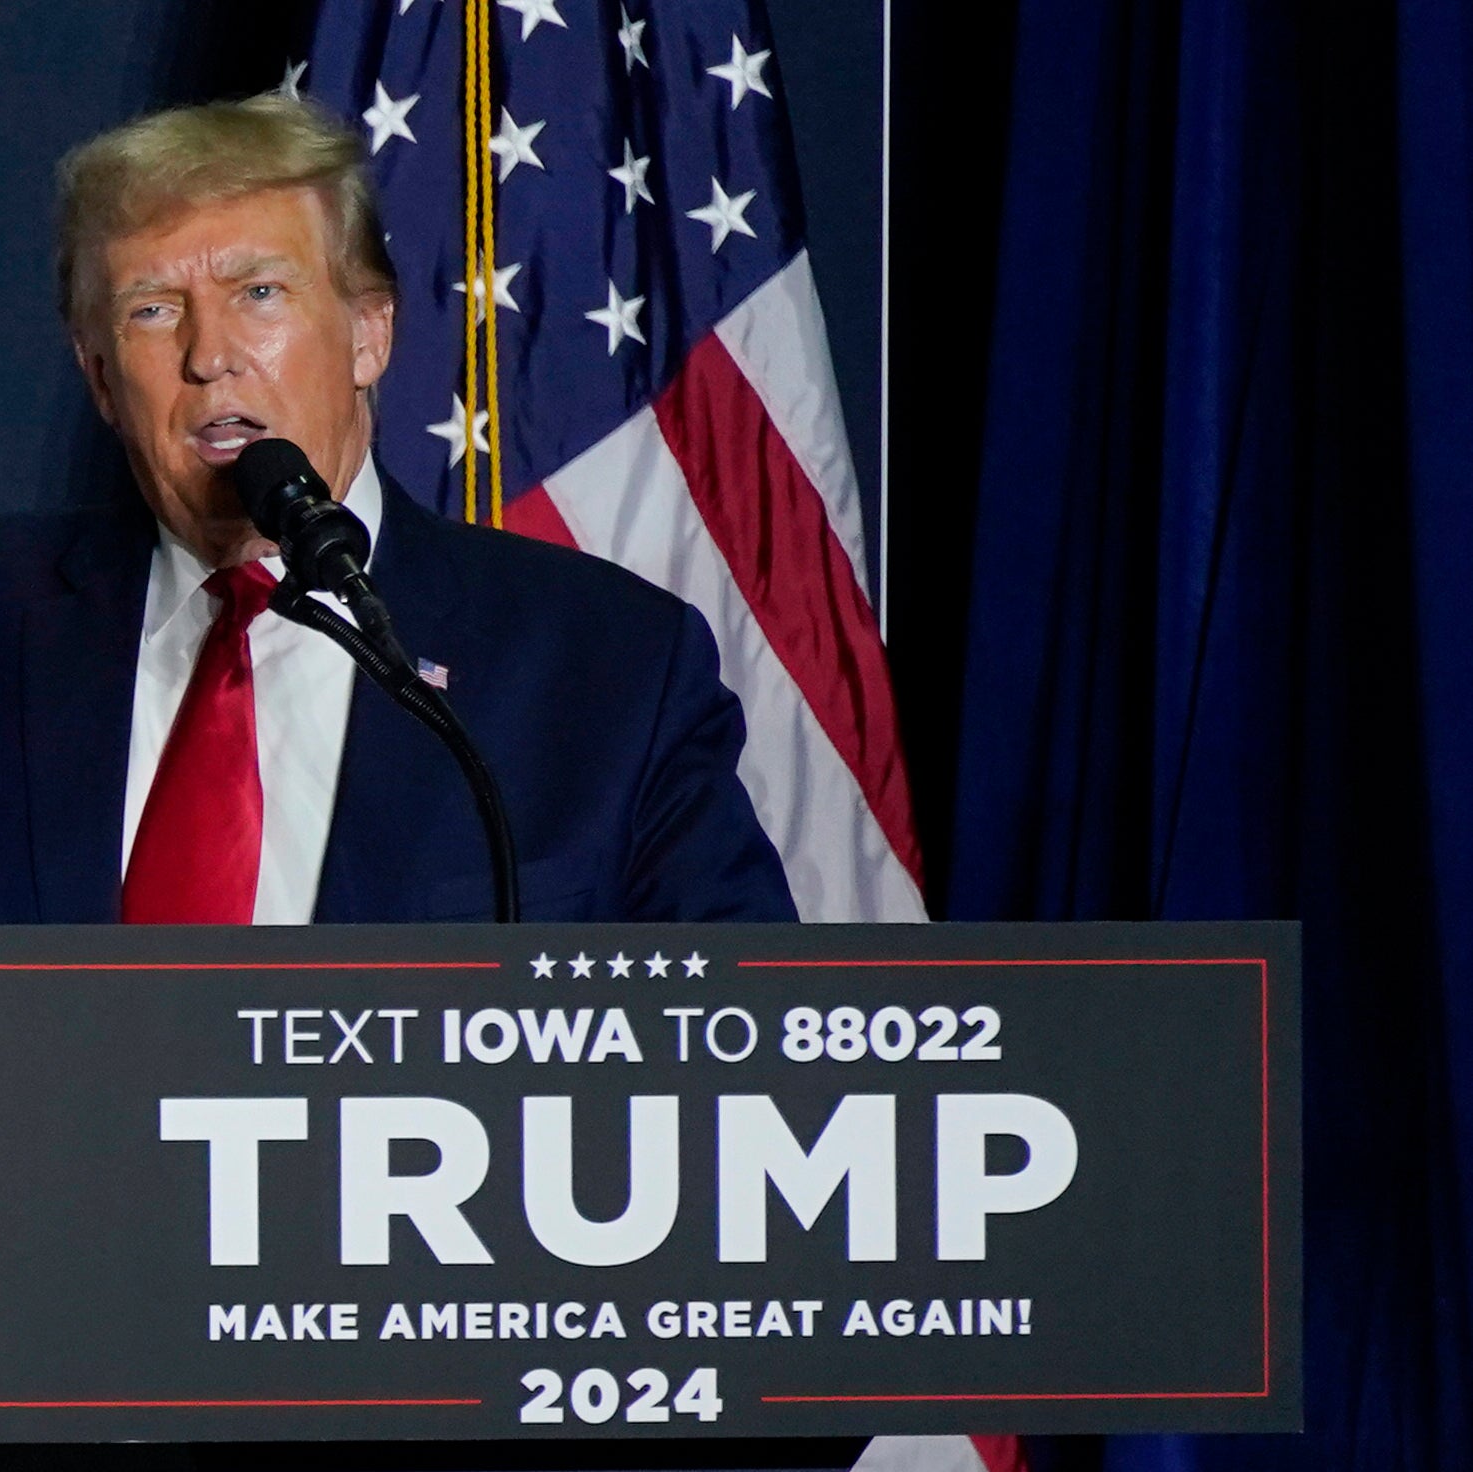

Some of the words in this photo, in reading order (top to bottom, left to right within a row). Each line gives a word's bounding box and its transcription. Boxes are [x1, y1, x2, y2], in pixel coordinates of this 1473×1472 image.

[238, 1010, 418, 1064] TEXT
[444, 1008, 643, 1063] IOWA
[664, 1007, 757, 1062] TO
[782, 1006, 1001, 1061] 88022
[160, 1094, 1077, 1266] TRUMP
[210, 1304, 358, 1340] MAKE
[380, 1302, 626, 1339] AMERICA
[648, 1301, 822, 1338] GREAT
[843, 1299, 1031, 1336] AGAIN!
[521, 1368, 722, 1423] 2024
